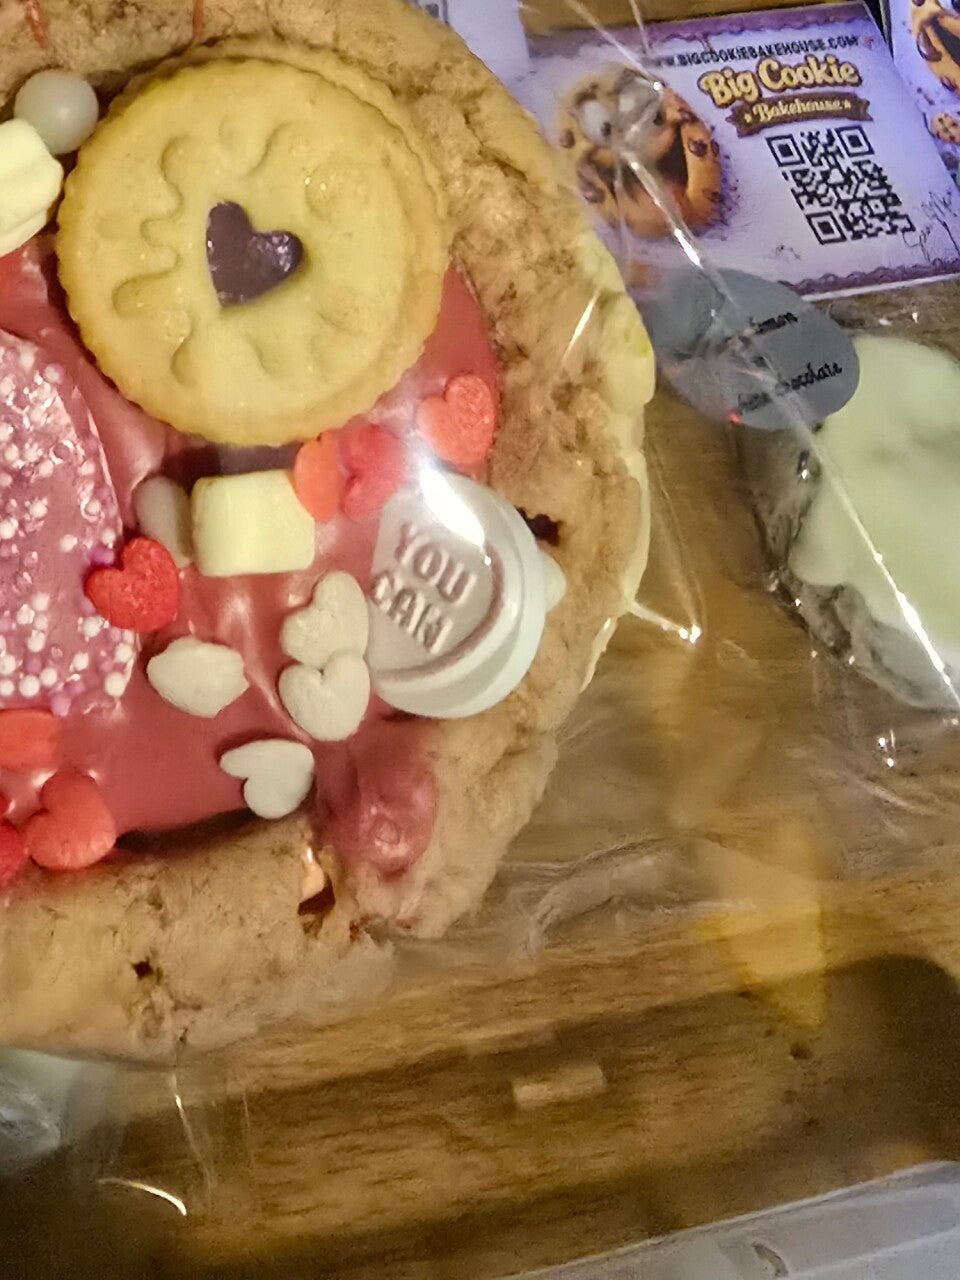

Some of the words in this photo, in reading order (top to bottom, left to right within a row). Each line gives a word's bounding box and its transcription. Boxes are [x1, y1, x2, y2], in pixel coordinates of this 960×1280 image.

[699, 67, 761, 107] Big
[756, 54, 862, 92] Cookie
[752, 97, 843, 122] Bakehouse
[395, 521, 477, 608] YOU
